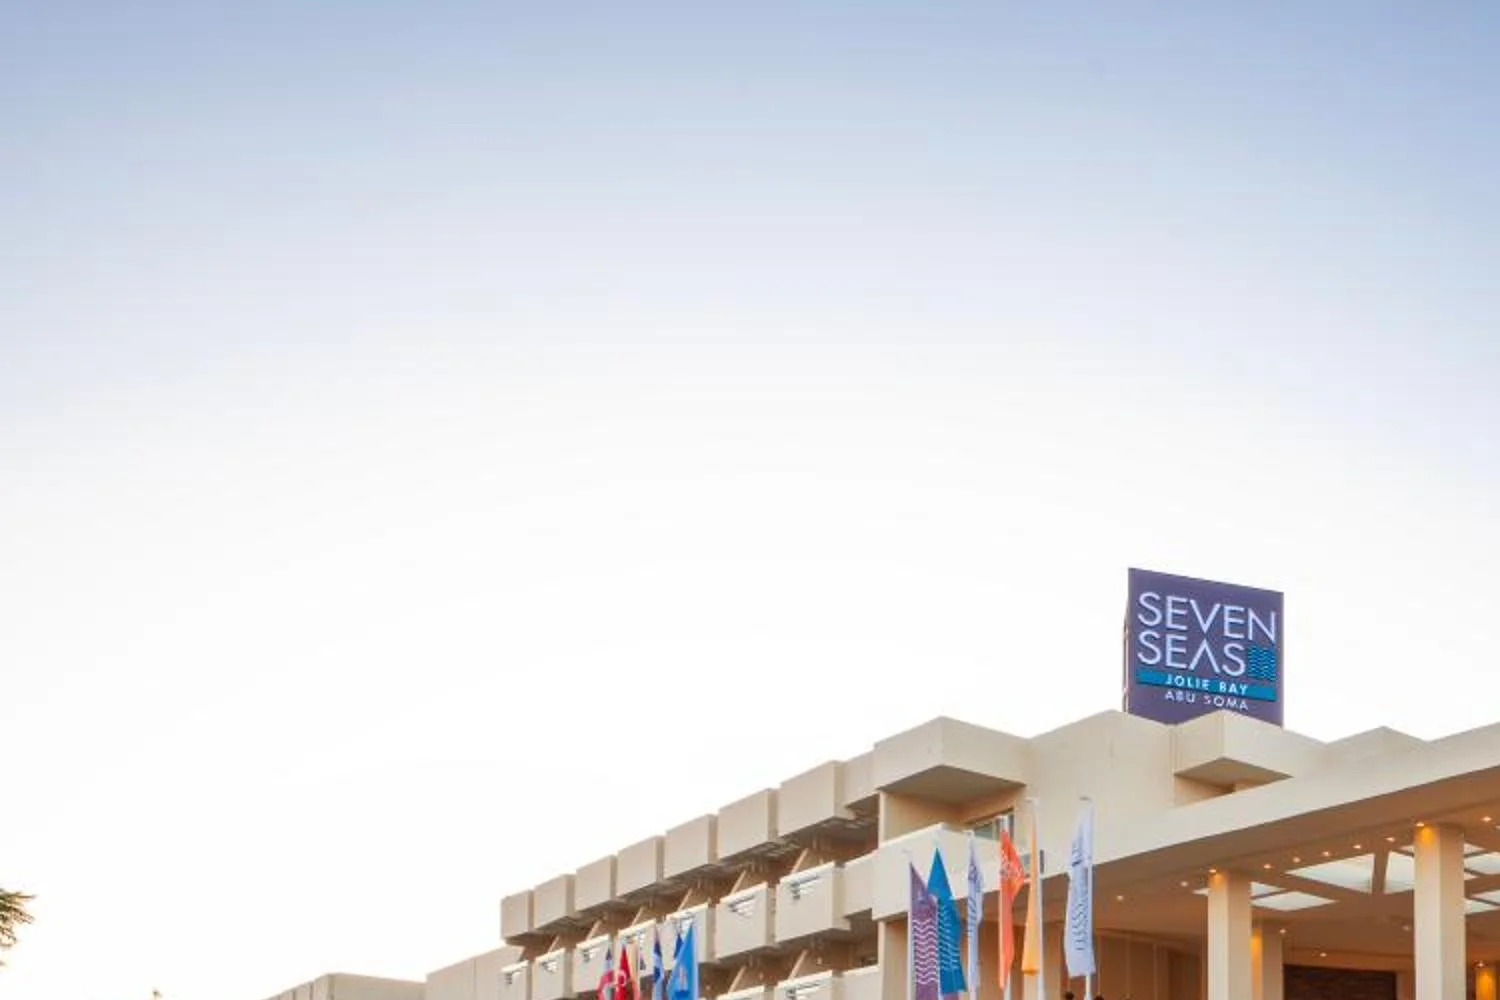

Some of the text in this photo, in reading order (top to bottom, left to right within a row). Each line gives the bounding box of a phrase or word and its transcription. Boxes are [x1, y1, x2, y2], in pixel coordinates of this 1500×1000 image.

[1137, 592, 1276, 644] SEVEN
[1137, 630, 1247, 677] SEAS
[1165, 674, 1249, 696] JOLIE BAY
[1165, 690, 1249, 711] ABU SOMA
